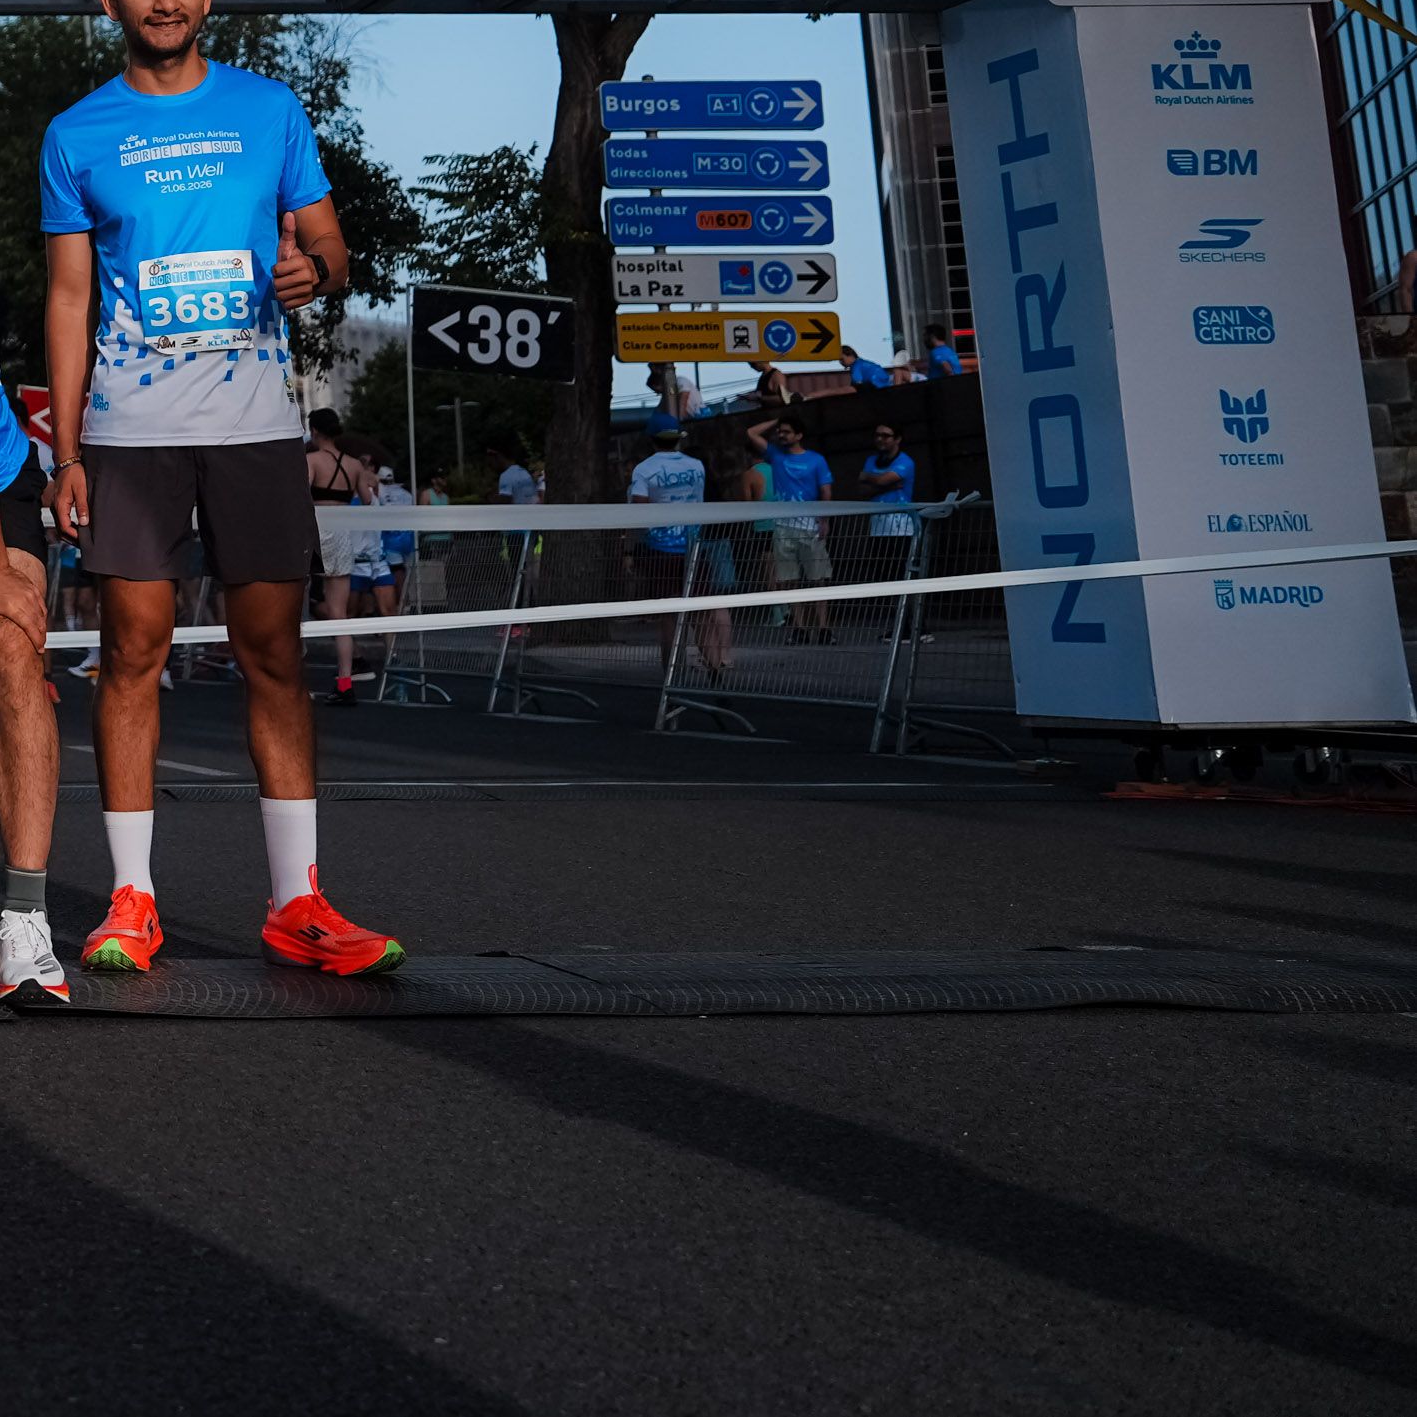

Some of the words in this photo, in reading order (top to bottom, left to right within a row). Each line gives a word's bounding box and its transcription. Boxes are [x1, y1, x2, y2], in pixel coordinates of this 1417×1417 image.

[1151, 63, 1253, 91] KLM
[605, 96, 681, 115] Burgos
[712, 96, 740, 113] A-1
[1155, 95, 1181, 107] Royal
[1183, 94, 1213, 106] Dutch
[1215, 94, 1255, 106] Airlines
[119, 139, 147, 151] KLM
[153, 135, 176, 143] Royal
[178, 132, 205, 140] Dutch
[121, 146, 171, 166] NORTE
[212, 141, 242, 153] SUR
[610, 147, 648, 160] todas
[1203, 149, 1258, 176] BM
[145, 169, 182, 184] Run
[187, 162, 224, 178] Well
[610, 166, 689, 180] direcciones
[696, 157, 743, 172] M-30
[161, 180, 212, 193] 21.06.2026
[614, 204, 687, 216] Colmenar
[616, 223, 653, 237] Viejo
[1179, 251, 1266, 263] SKECHERS
[617, 260, 683, 274] hospital
[150, 271, 186, 286] NORTE
[221, 268, 244, 278] SUR
[618, 281, 641, 296] La
[648, 281, 683, 296] Paz
[149, 291, 249, 326] 3683
[1198, 308, 1241, 327] SANI
[1199, 325, 1272, 343] CENTRO
[988, 47, 1107, 645] NORTH
[1218, 453, 1285, 466] TOTEEMI
[1208, 513, 1225, 533] EL
[1248, 511, 1313, 533] ESPAÑOL
[1239, 585, 1324, 607] MADRID
